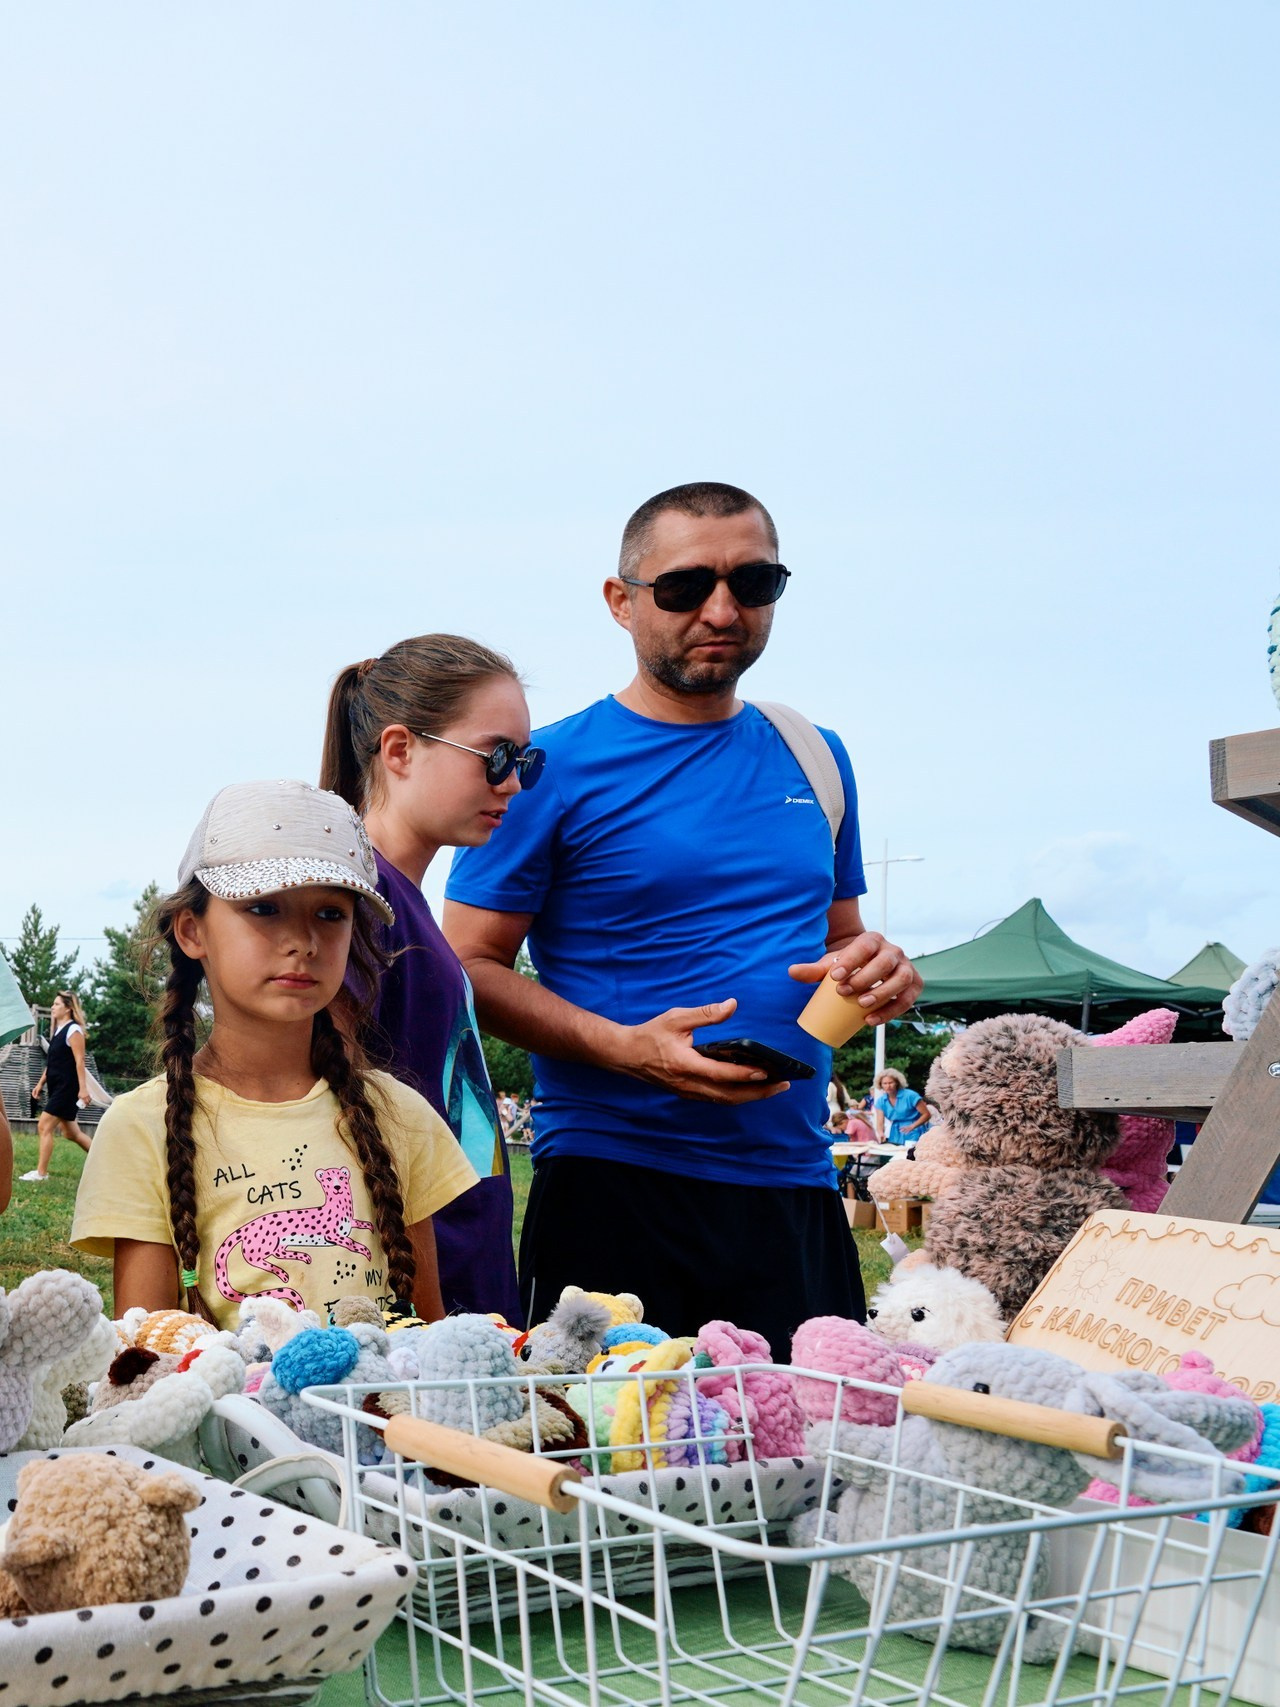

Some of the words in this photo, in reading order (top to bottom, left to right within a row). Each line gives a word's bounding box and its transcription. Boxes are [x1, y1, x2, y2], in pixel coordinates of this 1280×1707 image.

[213, 1163, 256, 1187] ALL
[246, 1180, 302, 1205] CATS
[364, 1268, 383, 1287] MY
[1020, 1305, 1043, 1329] С
[1115, 1276, 1227, 1341] ПРИВЕТ
